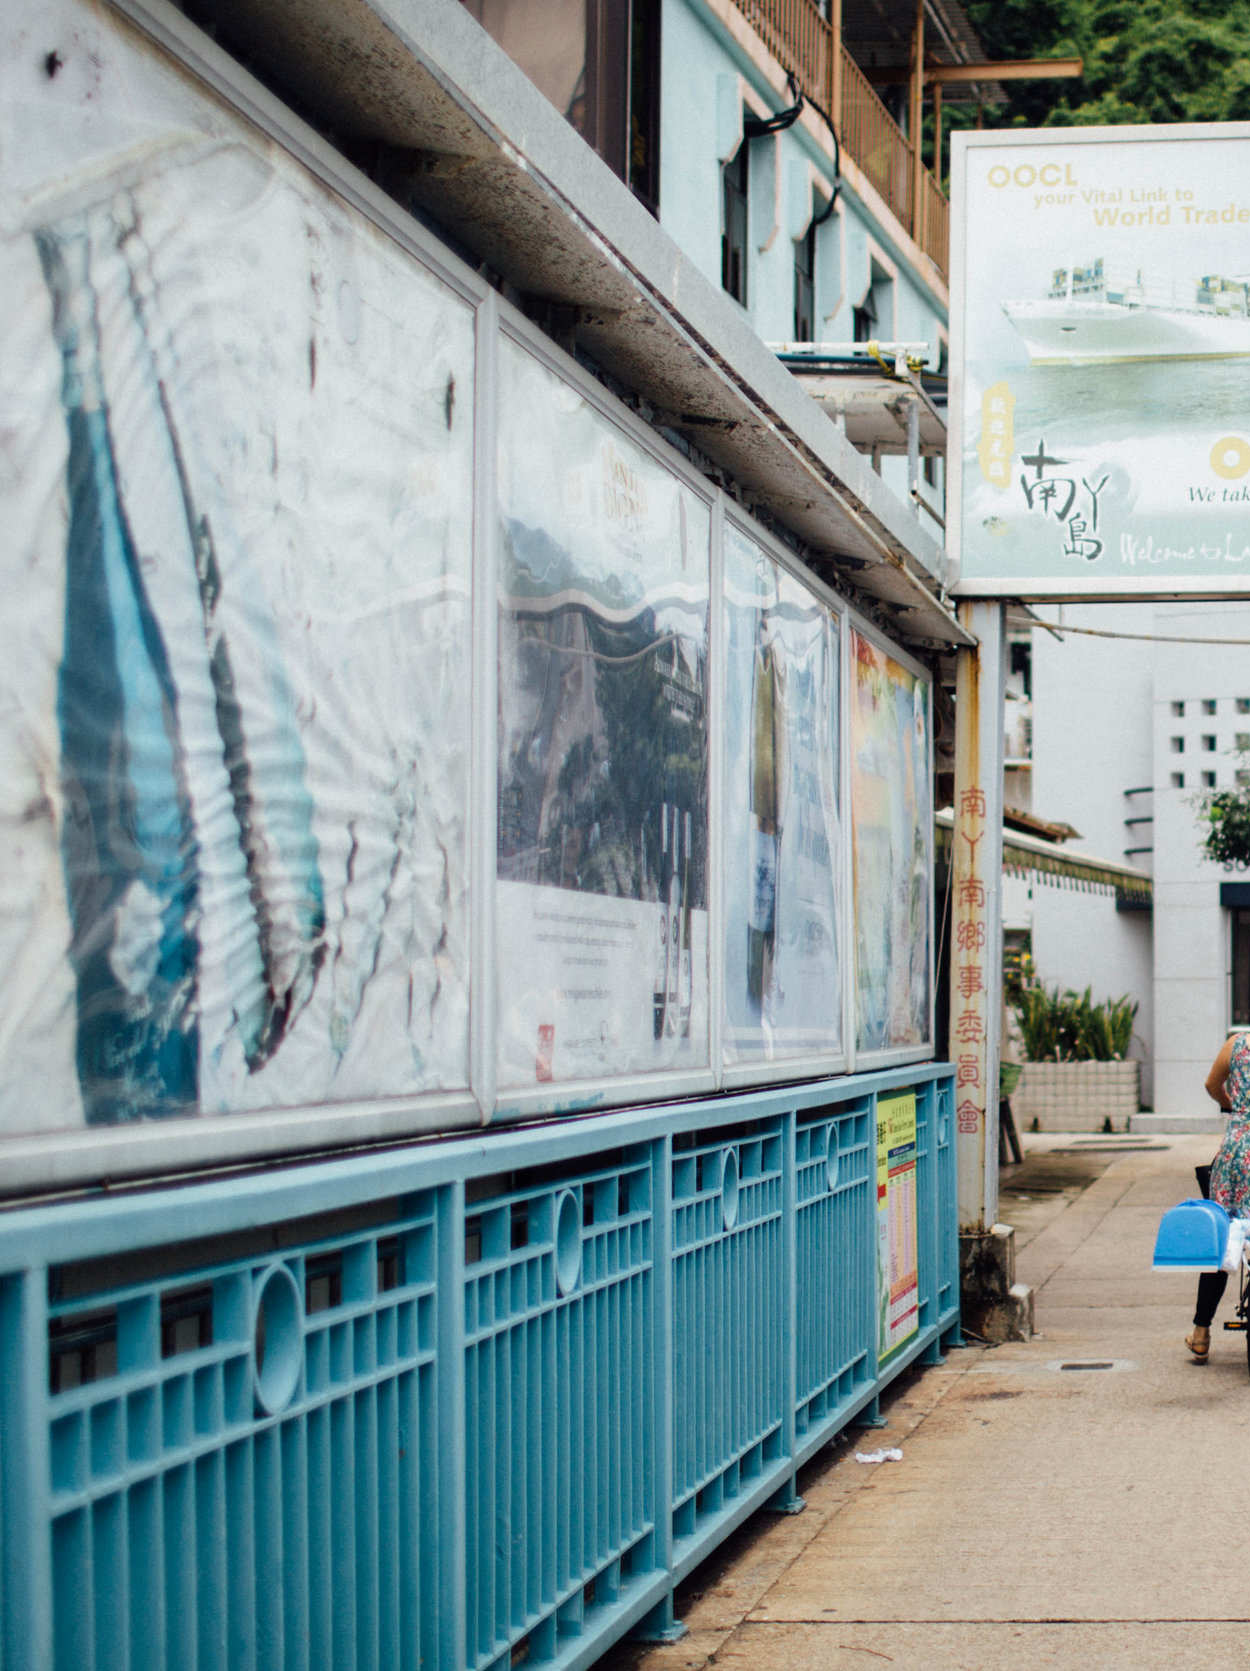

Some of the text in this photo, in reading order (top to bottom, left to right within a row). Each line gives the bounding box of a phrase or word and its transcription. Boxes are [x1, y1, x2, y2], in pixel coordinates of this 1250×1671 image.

[987, 163, 1078, 188] OOCL
[1034, 187, 1195, 209] your Vital Link to
[1093, 206, 1171, 227] World
[1189, 486, 1216, 502] We
[1120, 532, 1195, 566] Welcome
[1201, 541, 1223, 561] to
[955, 785, 986, 1135] 南丫南鄉事委員會
